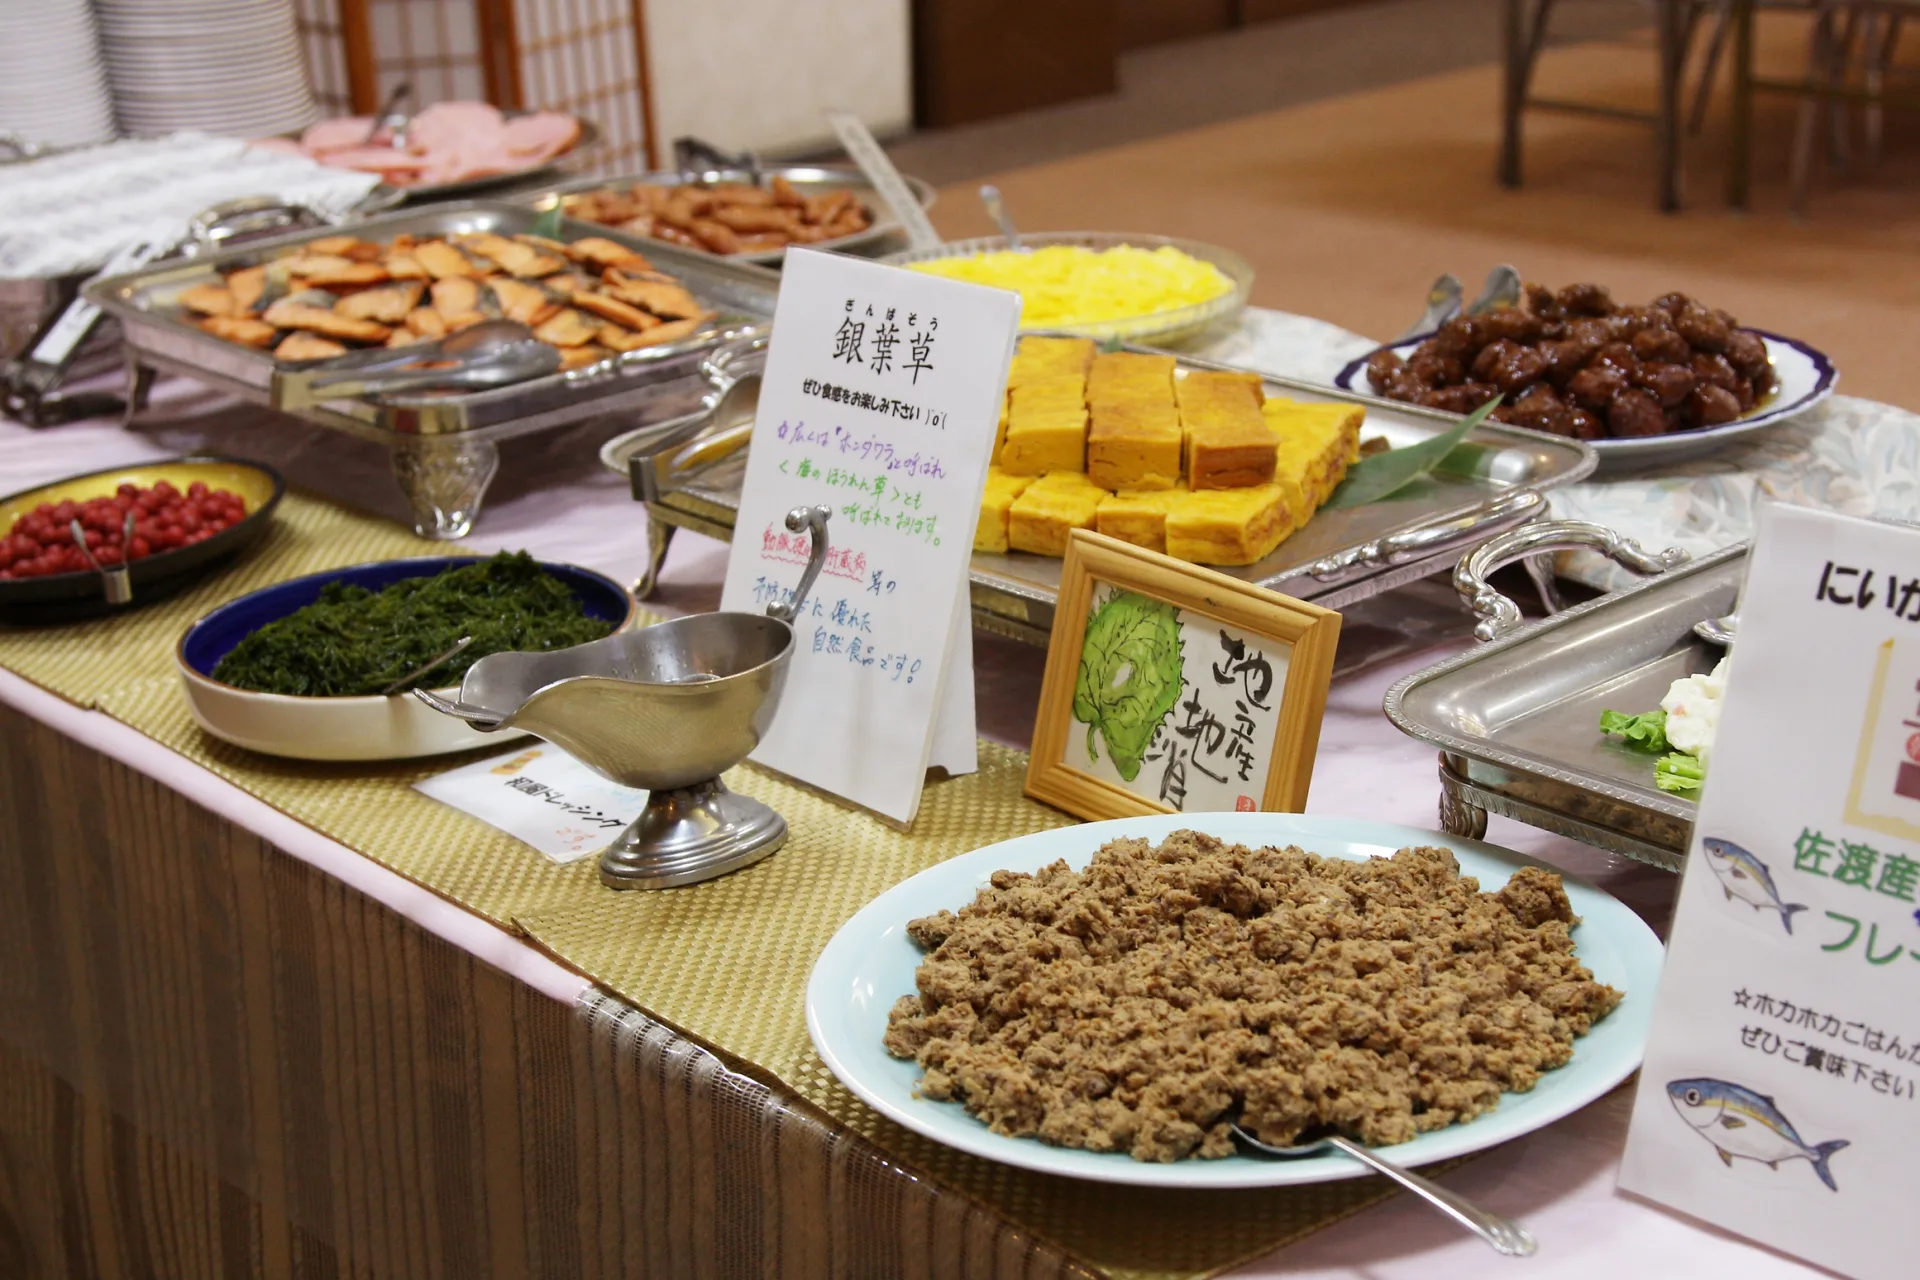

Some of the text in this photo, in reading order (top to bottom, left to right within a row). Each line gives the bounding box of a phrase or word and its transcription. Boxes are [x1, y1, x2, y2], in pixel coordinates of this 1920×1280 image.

[833, 315, 935, 386] 銀葉草
[802, 377, 921, 421] ぜひ食感をお楽しみ下さい
[1793, 826, 1920, 903] 佐渡産
[1740, 1024, 1915, 1100] ぜひご賞味下さい
